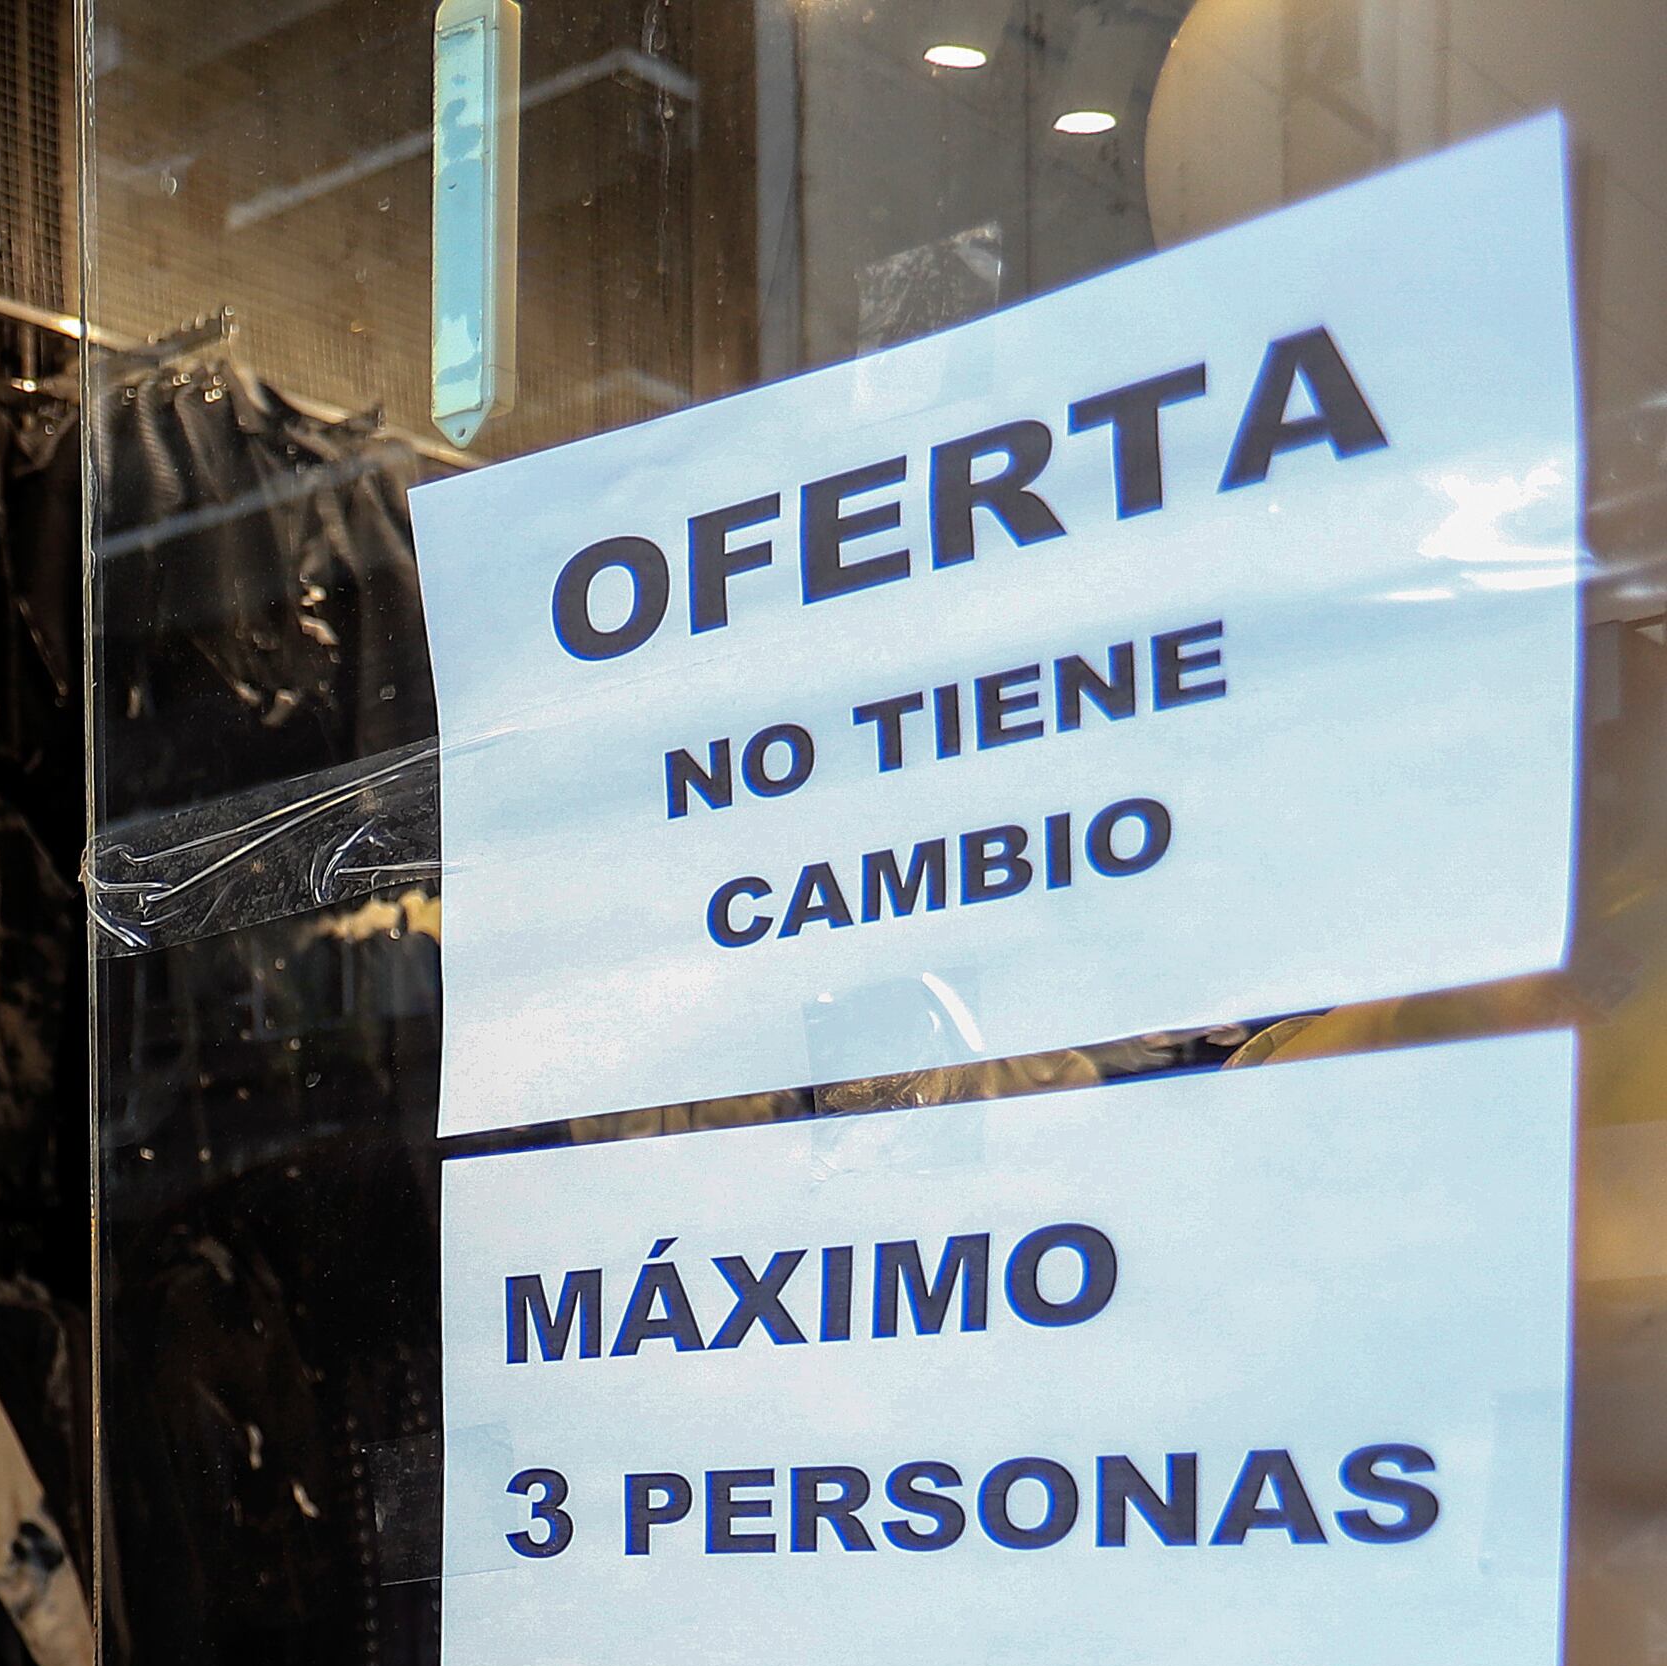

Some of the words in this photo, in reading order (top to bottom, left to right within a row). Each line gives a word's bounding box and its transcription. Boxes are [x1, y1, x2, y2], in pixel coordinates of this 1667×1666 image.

[550, 324, 1389, 662] OFERTA
[663, 724, 816, 820] NO
[852, 620, 1229, 773] TIENE
[705, 798, 1173, 949] CAMBIO
[504, 1222, 1120, 1364] MÁXIMO
[504, 1467, 574, 1559] 3
[623, 1443, 1441, 1556] PERSONAS
